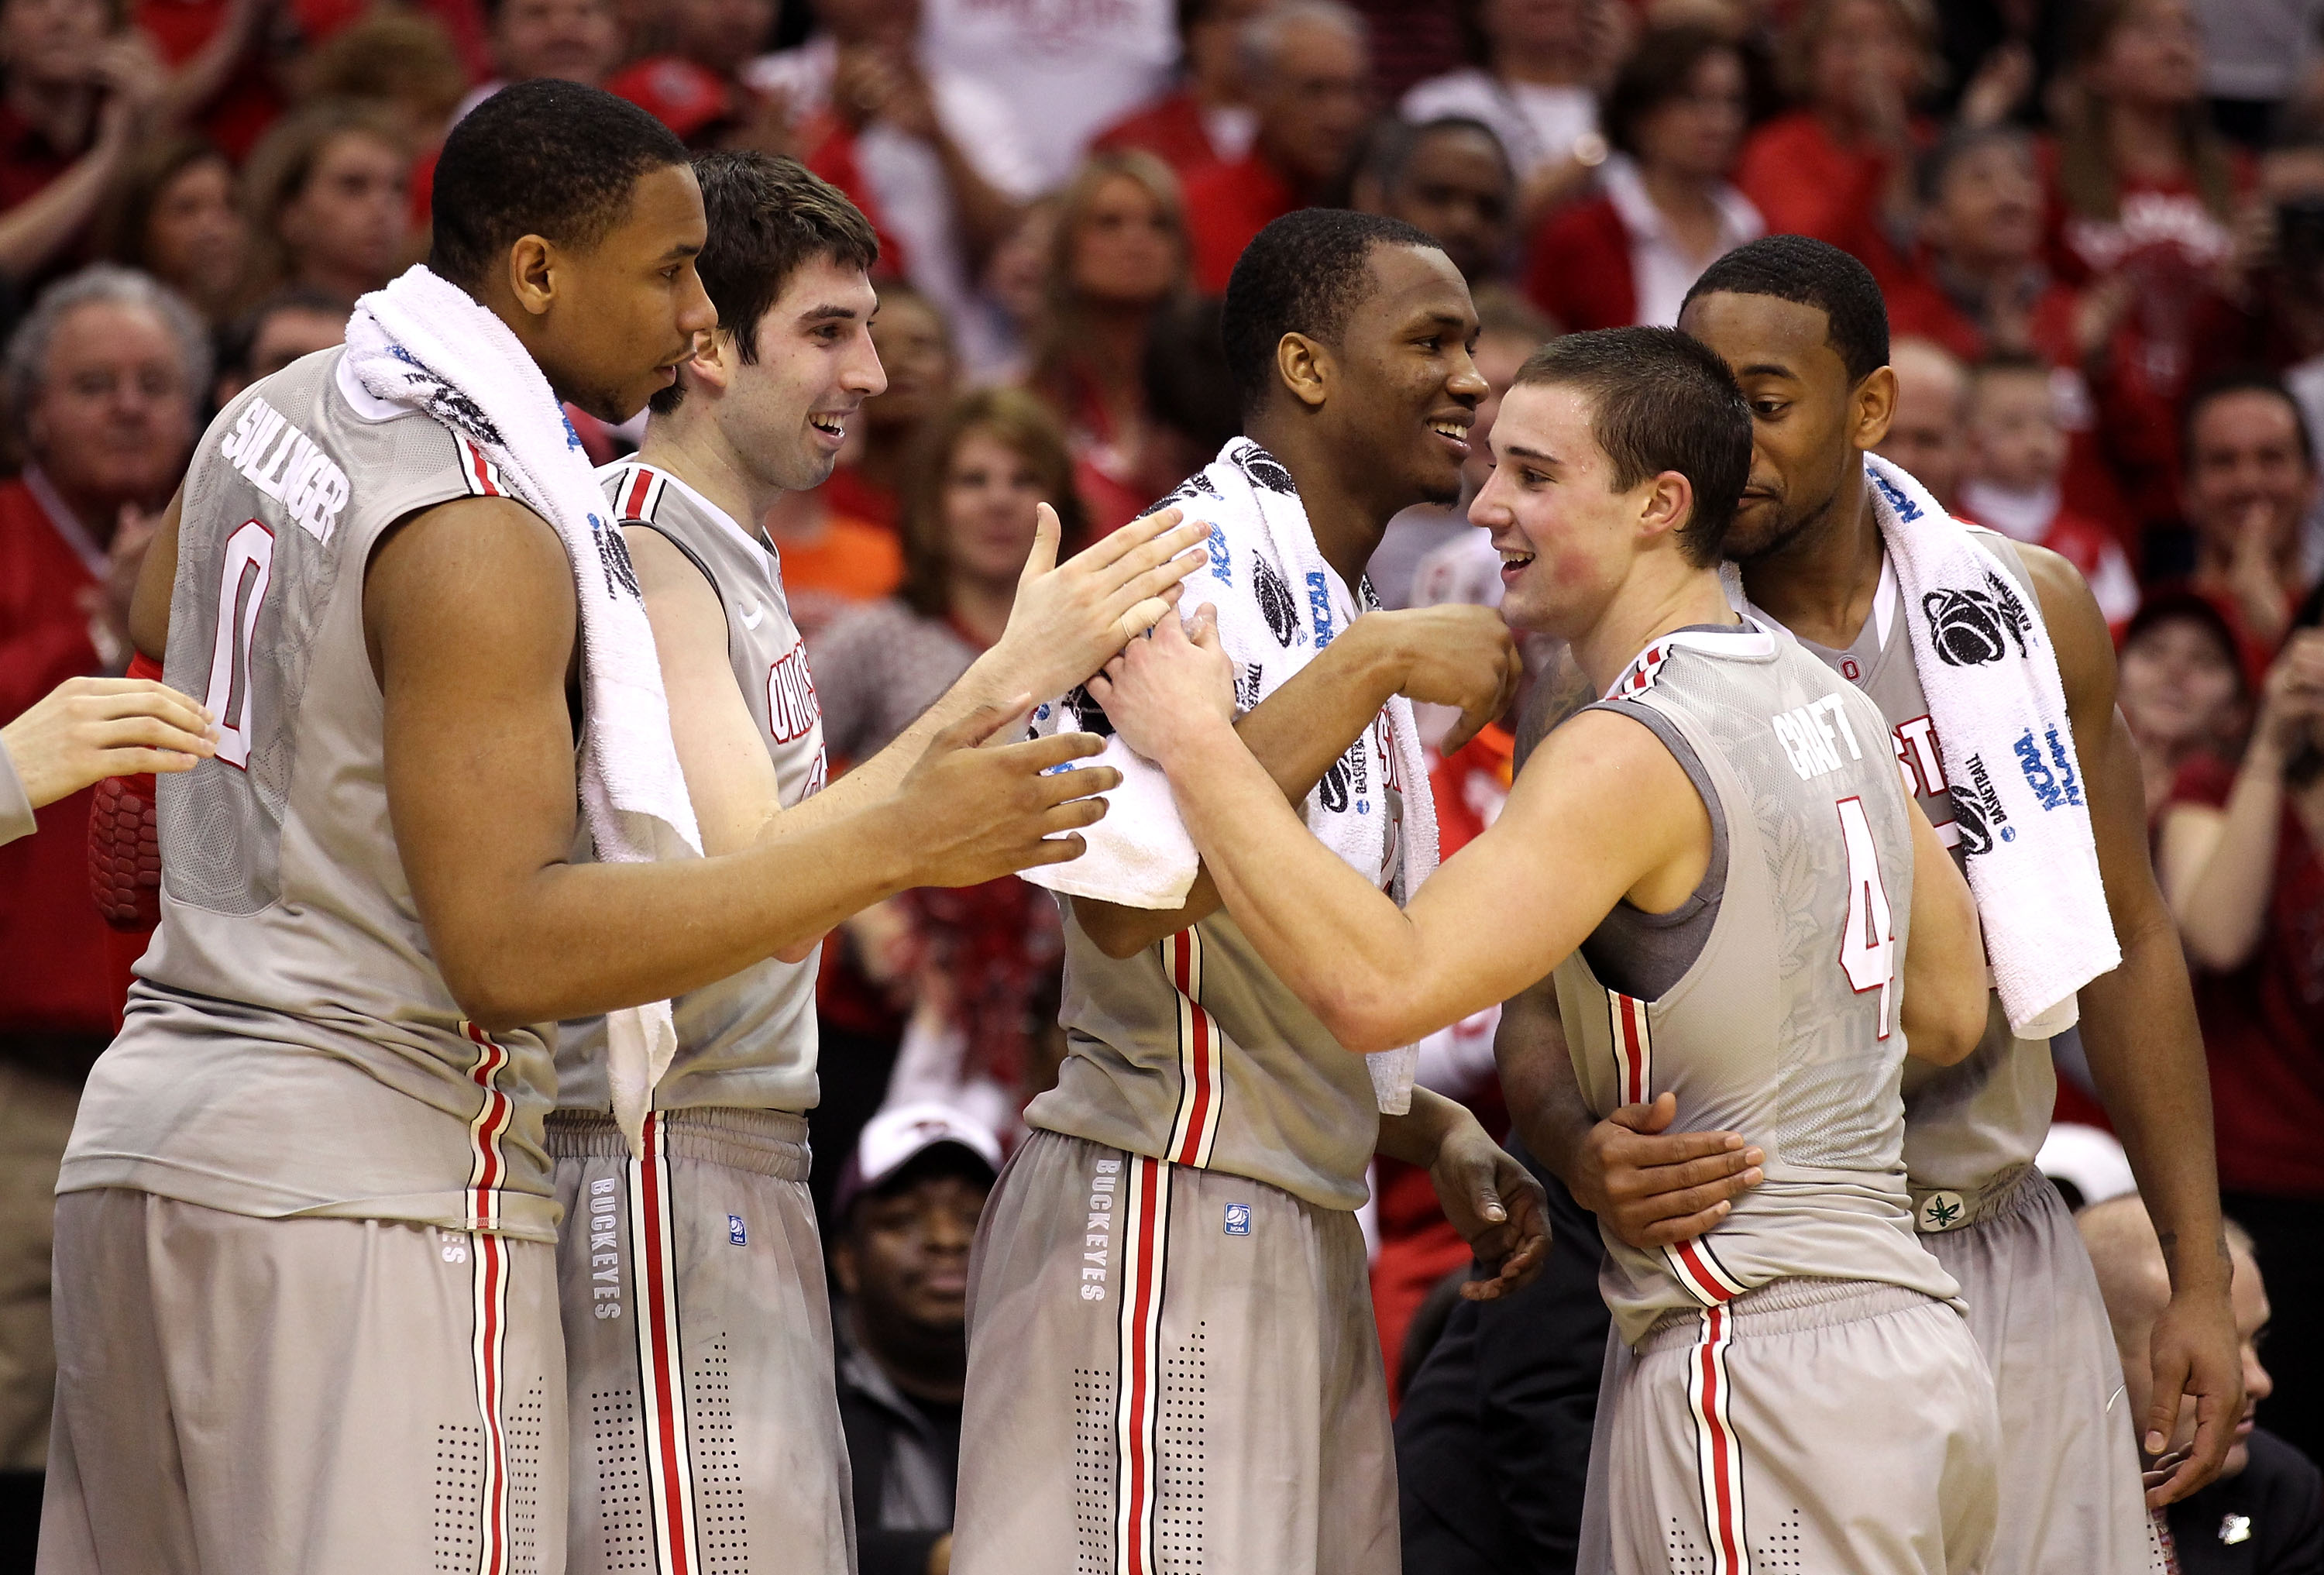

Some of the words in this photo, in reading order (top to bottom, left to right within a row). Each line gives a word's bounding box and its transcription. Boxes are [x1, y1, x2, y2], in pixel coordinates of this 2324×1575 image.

[222, 397, 350, 548] SULLINGER
[204, 517, 275, 772] 0
[1772, 693, 1862, 781] CRAFT
[1965, 752, 2008, 826] BASKETBALL
[1835, 795, 1895, 1041] 4
[590, 1178, 621, 1320] BUCKEYES
[1081, 1159, 1121, 1303] BUCKEYES
